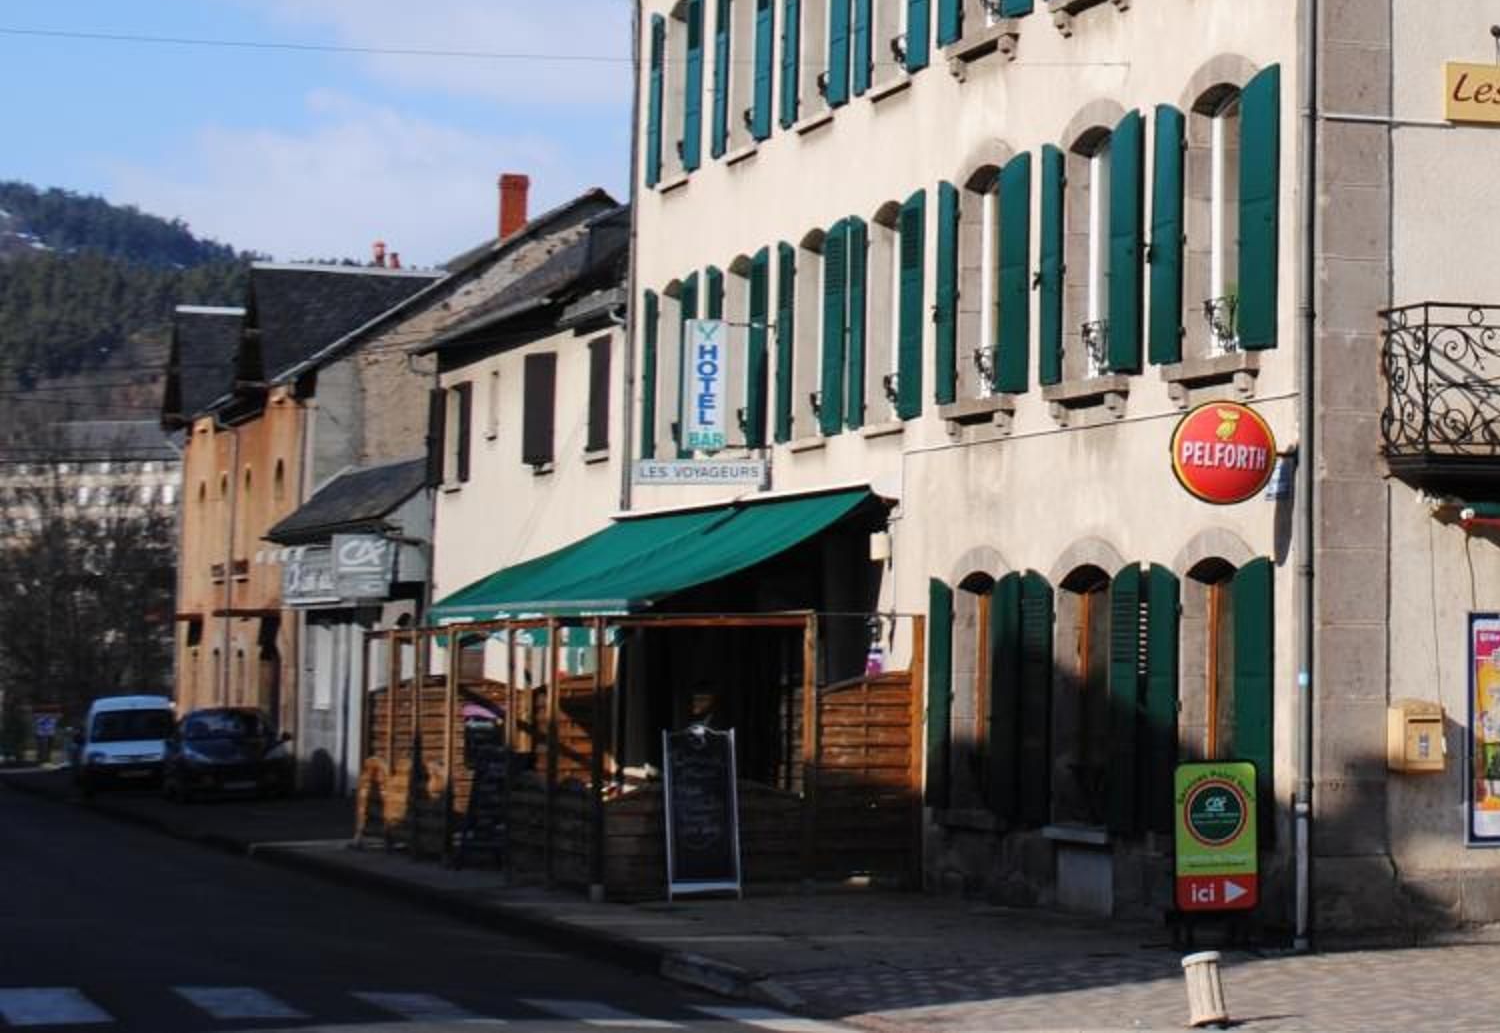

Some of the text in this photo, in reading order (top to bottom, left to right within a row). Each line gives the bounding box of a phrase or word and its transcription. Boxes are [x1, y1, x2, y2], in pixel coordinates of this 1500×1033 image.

[697, 344, 719, 426] HOTEL
[688, 432, 724, 446] BAR
[1181, 441, 1267, 470] PELFORTH
[640, 466, 759, 478] LES VOYAGEURS
[1191, 883, 1215, 903] ici
